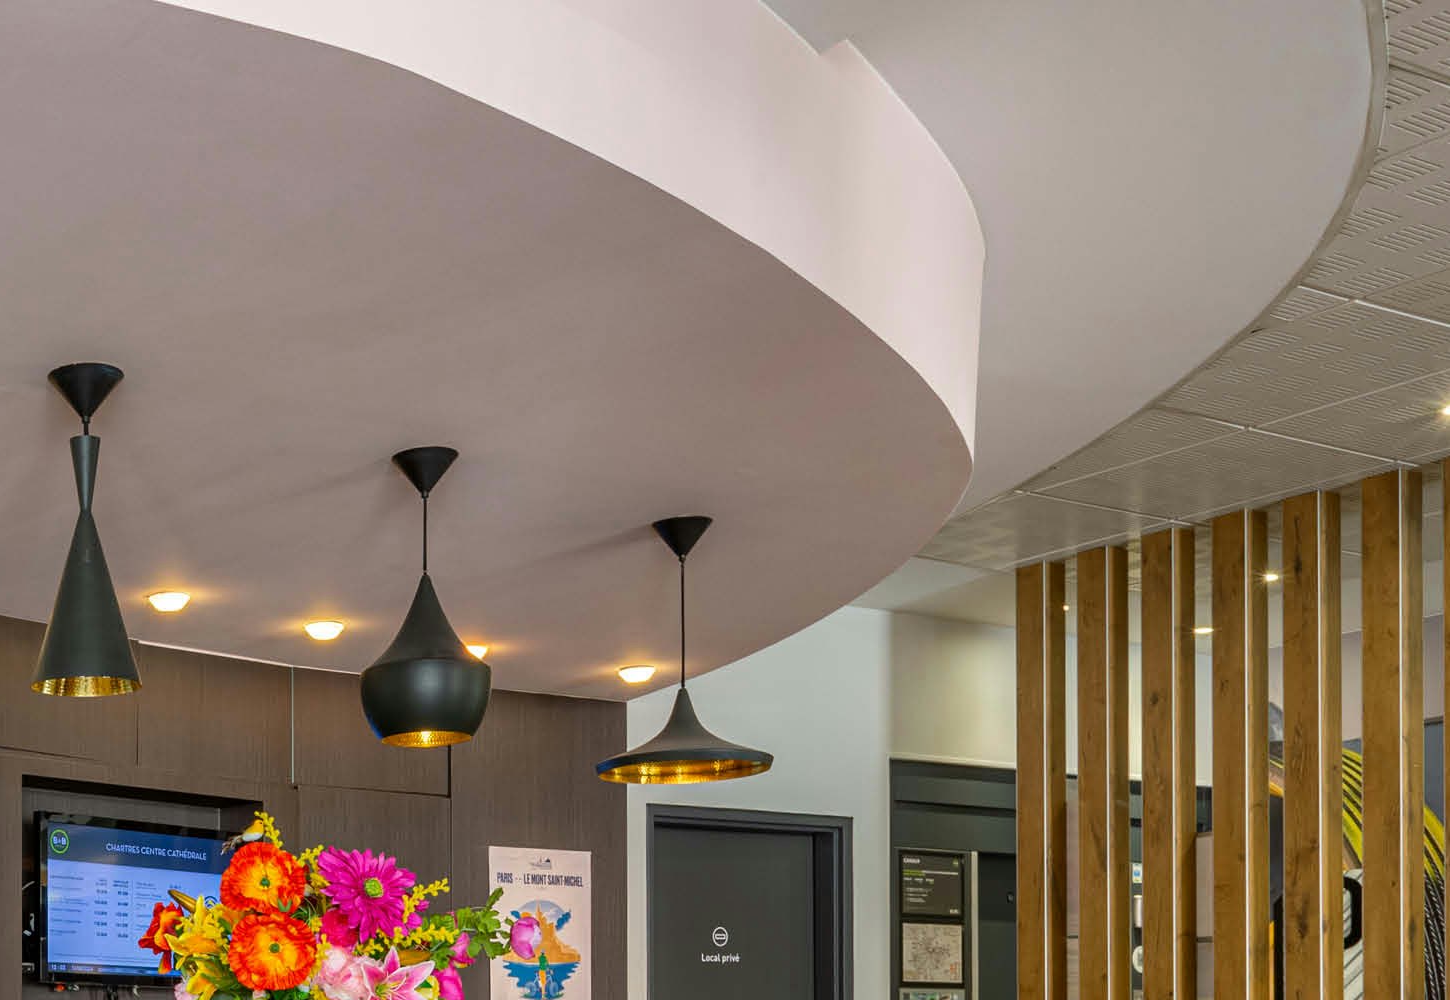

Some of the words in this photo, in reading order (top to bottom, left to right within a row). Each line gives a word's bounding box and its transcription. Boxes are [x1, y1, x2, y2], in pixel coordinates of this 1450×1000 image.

[105, 843, 140, 854] CHARTRES
[140, 846, 167, 857] CENTRE
[167, 849, 207, 861] CATHÉDRALE
[496, 872, 513, 884] PARIS
[523, 873, 531, 885] LE
[531, 874, 547, 886] MONT
[547, 875, 583, 887] SAINT-MICHEL
[701, 953, 720, 962] Local
[721, 952, 740, 965] privé
